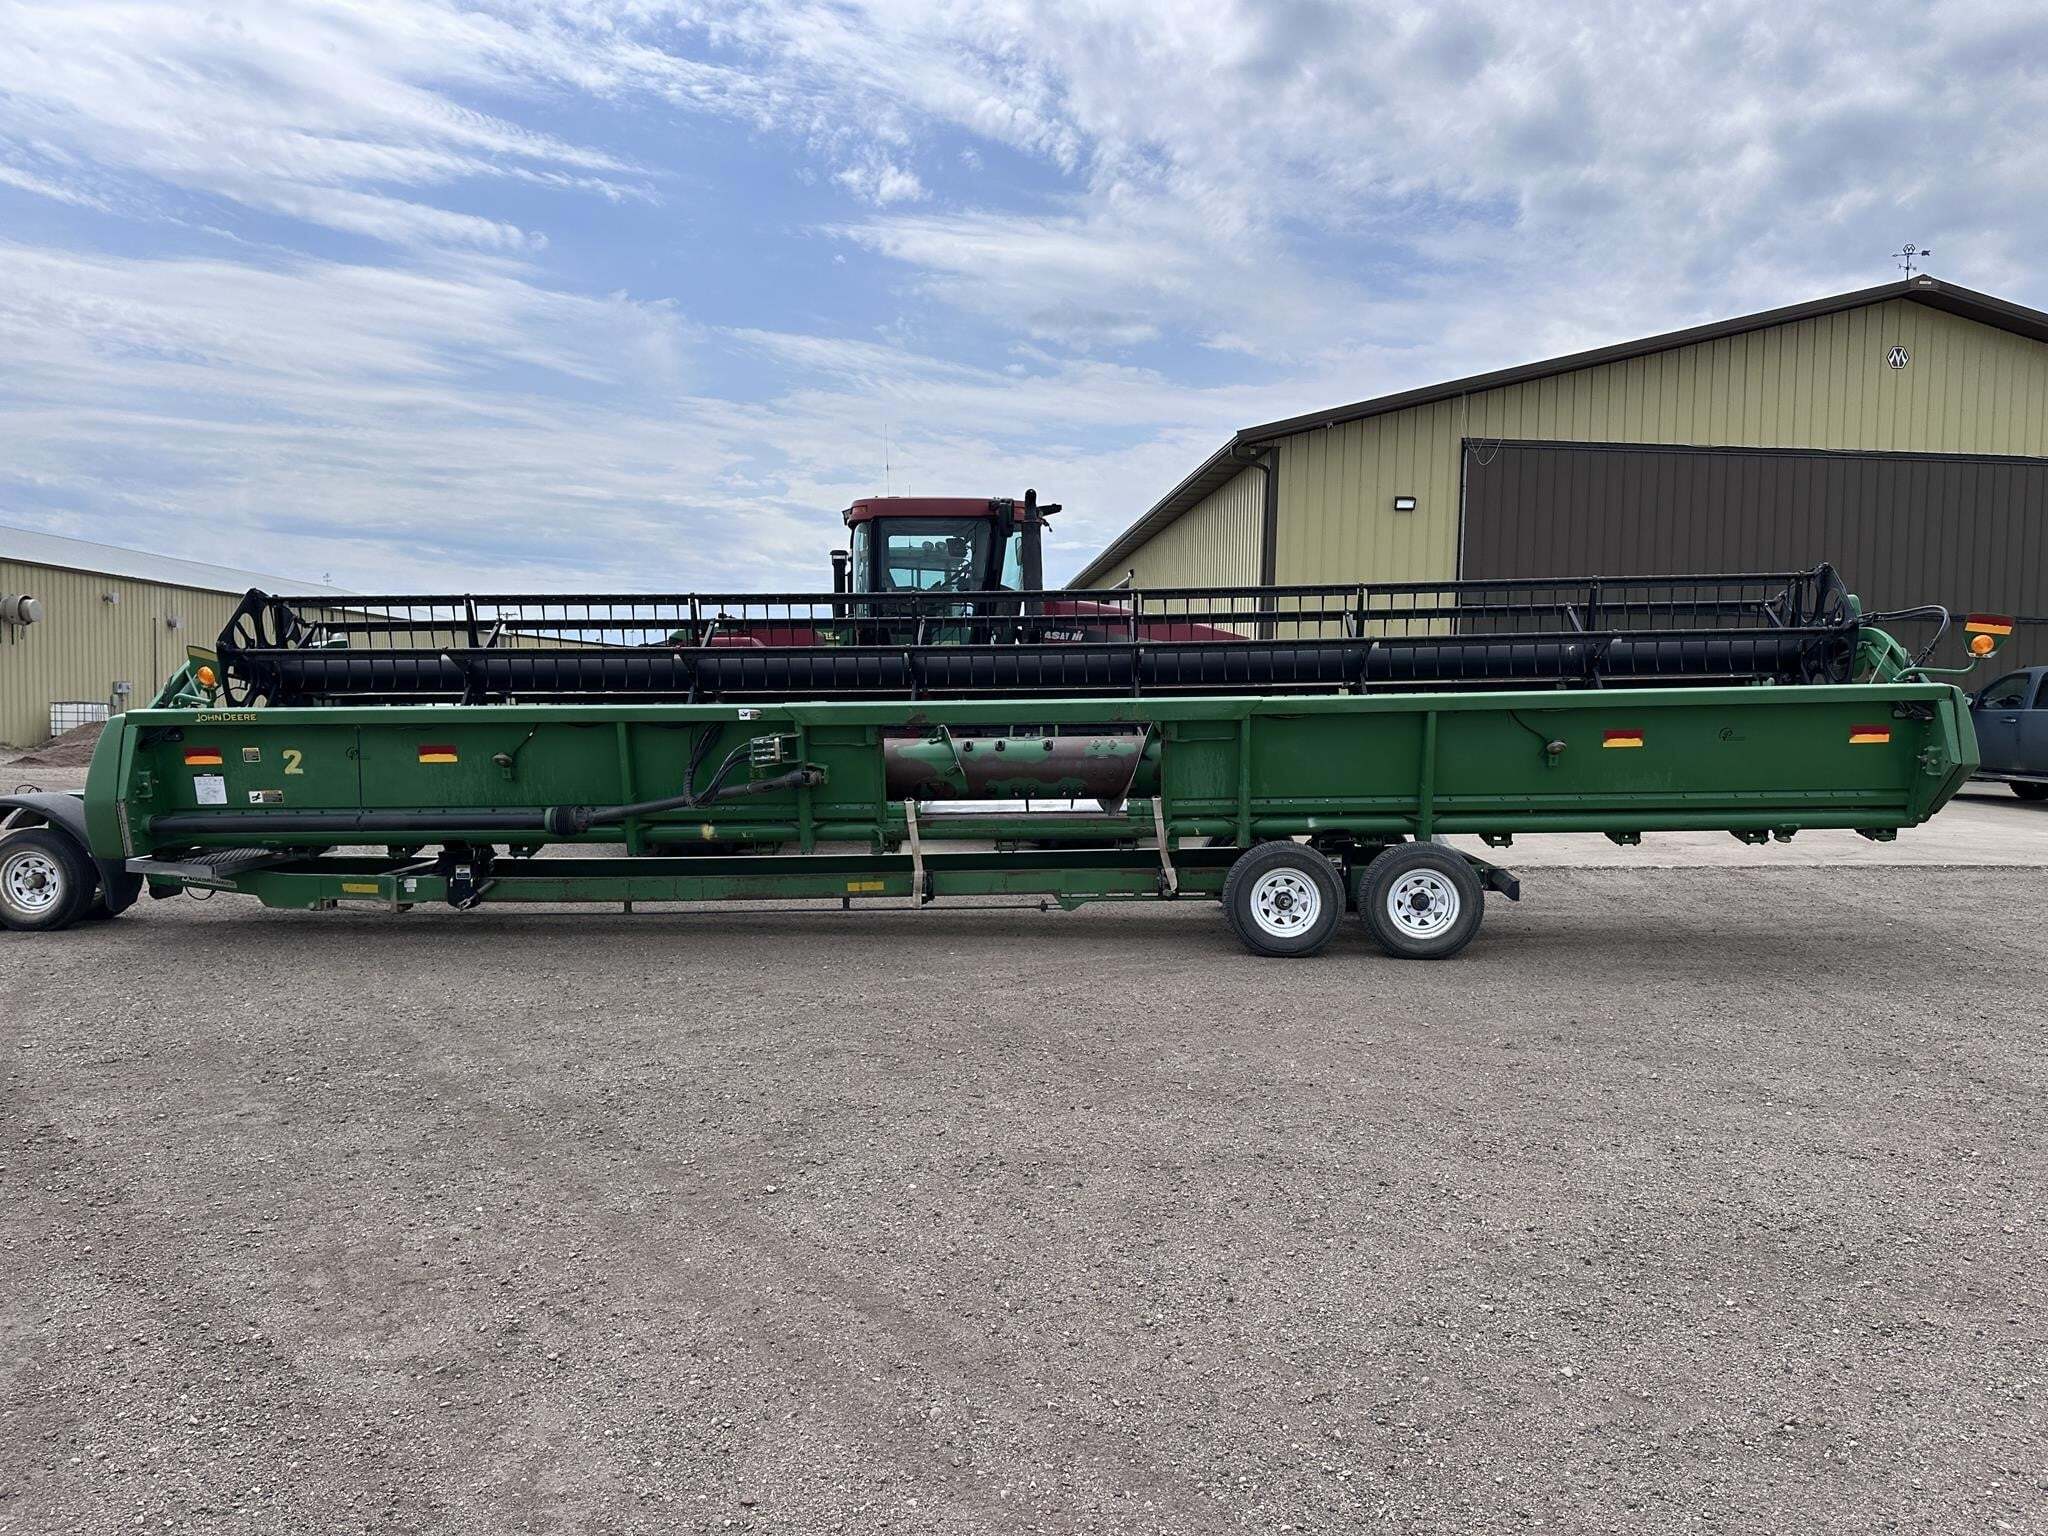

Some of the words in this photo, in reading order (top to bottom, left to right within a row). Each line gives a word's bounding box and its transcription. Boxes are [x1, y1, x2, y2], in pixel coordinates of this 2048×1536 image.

[196, 713, 222, 722] JOHN
[223, 713, 257, 721] DEERE
[282, 750, 304, 774] 2
